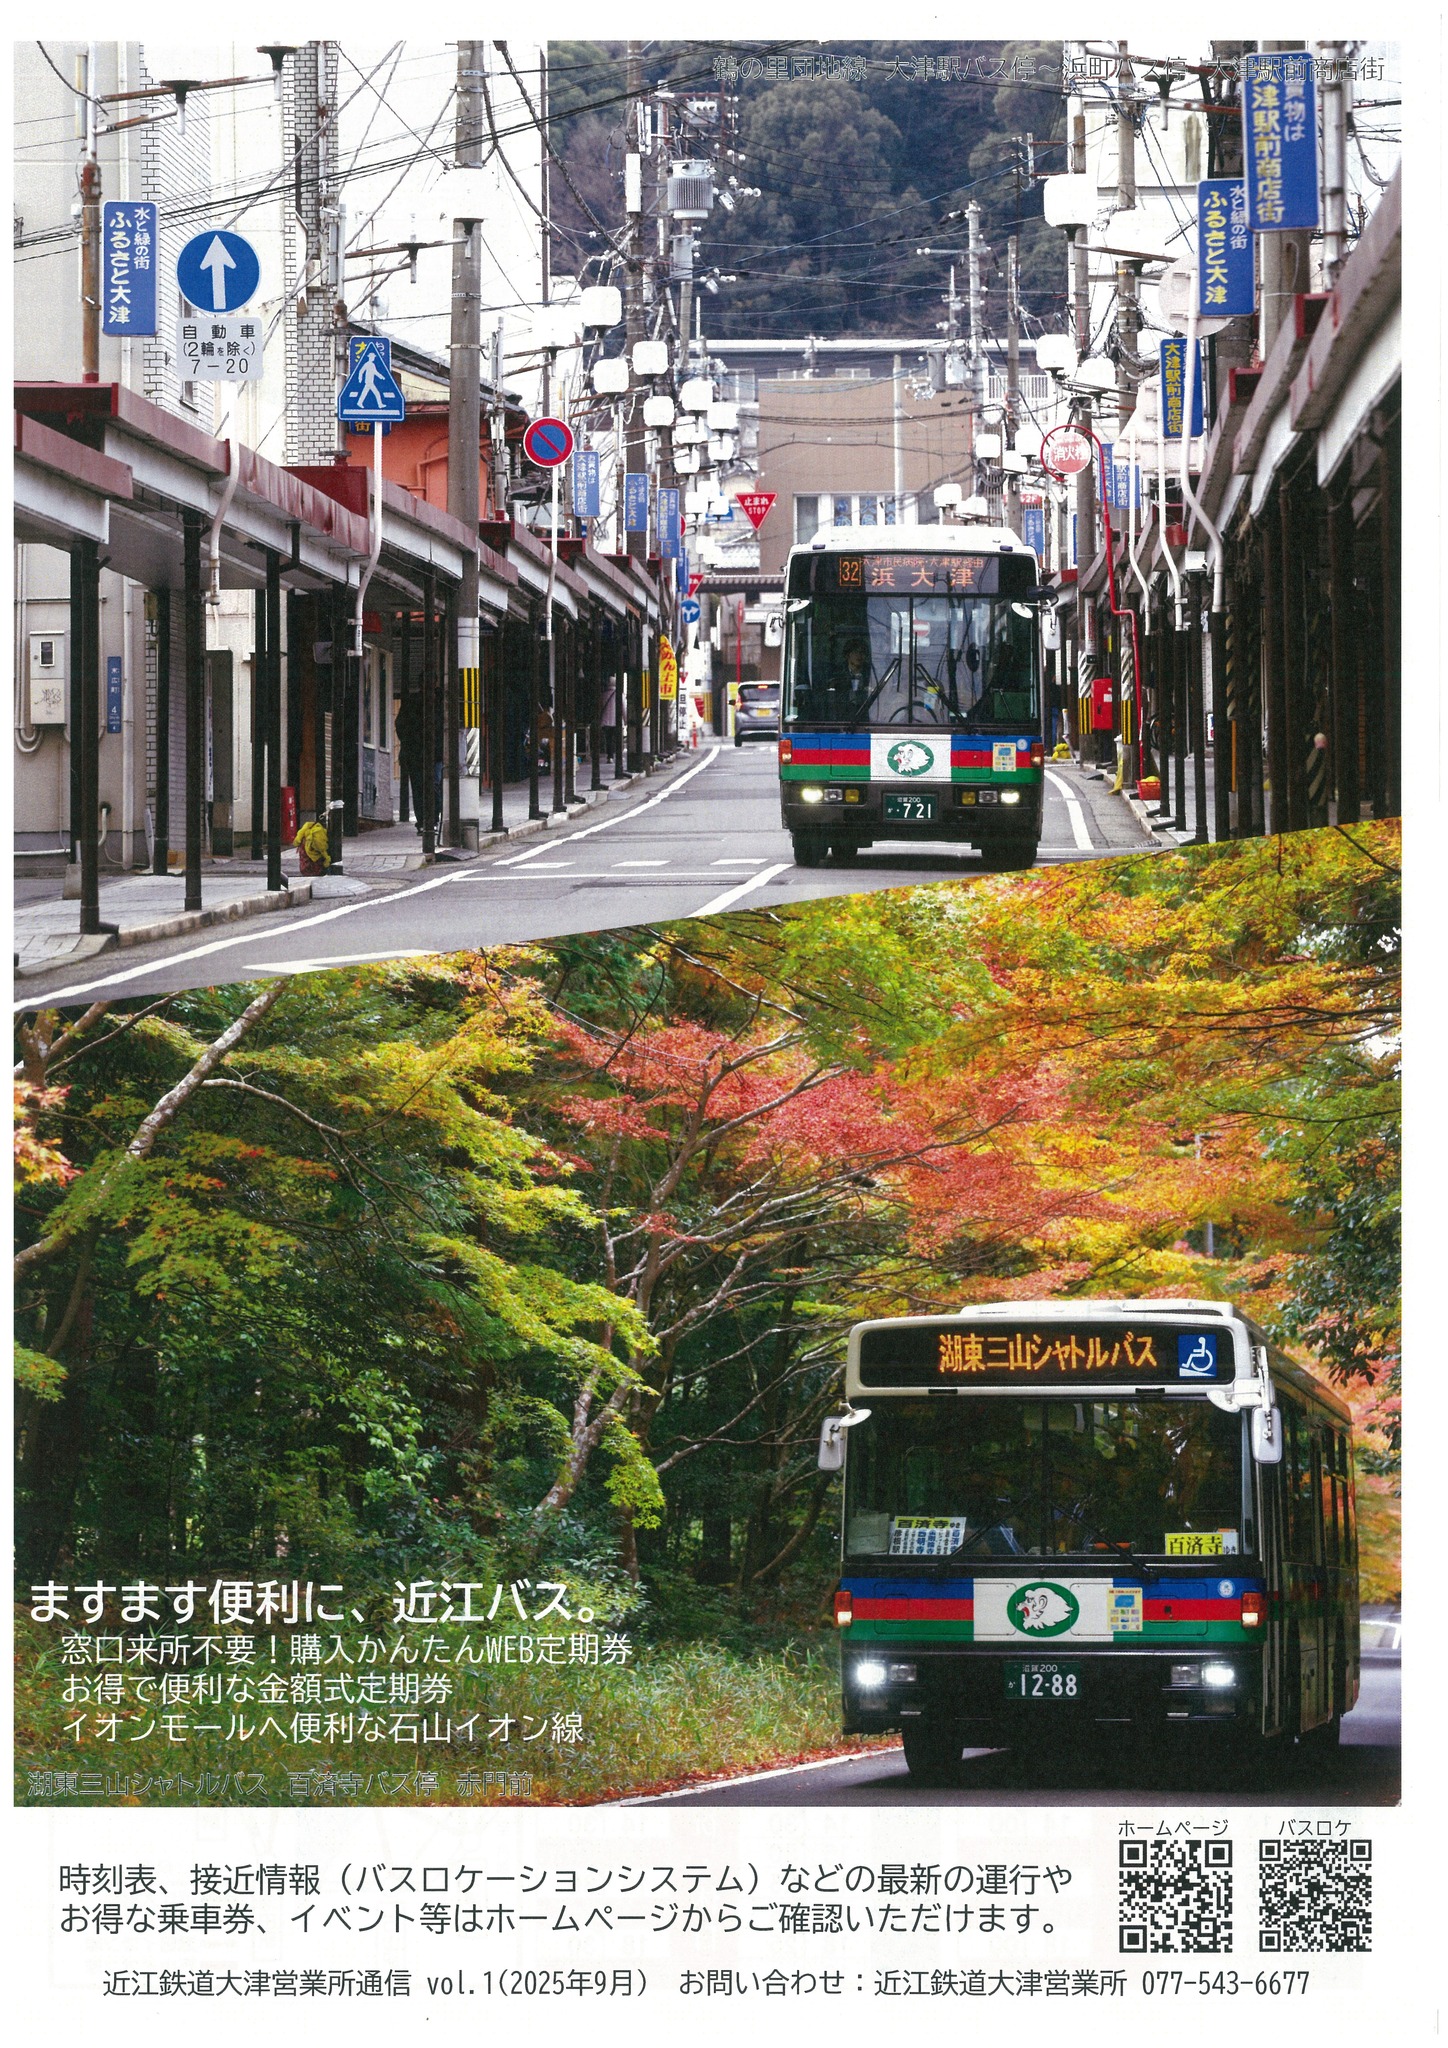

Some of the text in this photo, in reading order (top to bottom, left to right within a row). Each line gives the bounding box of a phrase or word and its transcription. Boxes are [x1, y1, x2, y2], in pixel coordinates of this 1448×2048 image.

[133, 207, 151, 270] 水と緑の街
[1203, 190, 1229, 305] ふるさと大津
[108, 211, 132, 324] ふるさと大津
[182, 324, 256, 340] 自動車
[1164, 342, 1183, 434] 大津駅前商店街
[744, 496, 770, 506] 止まれ
[748, 506, 766, 515] STOP
[842, 561, 859, 581] 32
[871, 567, 975, 587] 浜大津
[939, 1331, 1158, 1373] 湖東三山シャトルバス
[1021, 1674, 1077, 1696] 12-88
[1118, 1819, 1229, 1837] ホームページ
[1278, 1819, 1352, 1837] バスロケ
[59, 1863, 1073, 1896] 時刻表、接近情報（バスロケーションシステム）などの最新の運行や
[61, 1903, 1057, 1935] お得な乗車券、イベント等はホームページからご確認いただけます。
[103, 1968, 411, 1997] 近江鉄道大津営業所通信
[679, 1968, 1127, 1998] お問い合わせ：近江鉄道大津営業所
[1142, 1971, 1310, 1995] 077-543-6677
